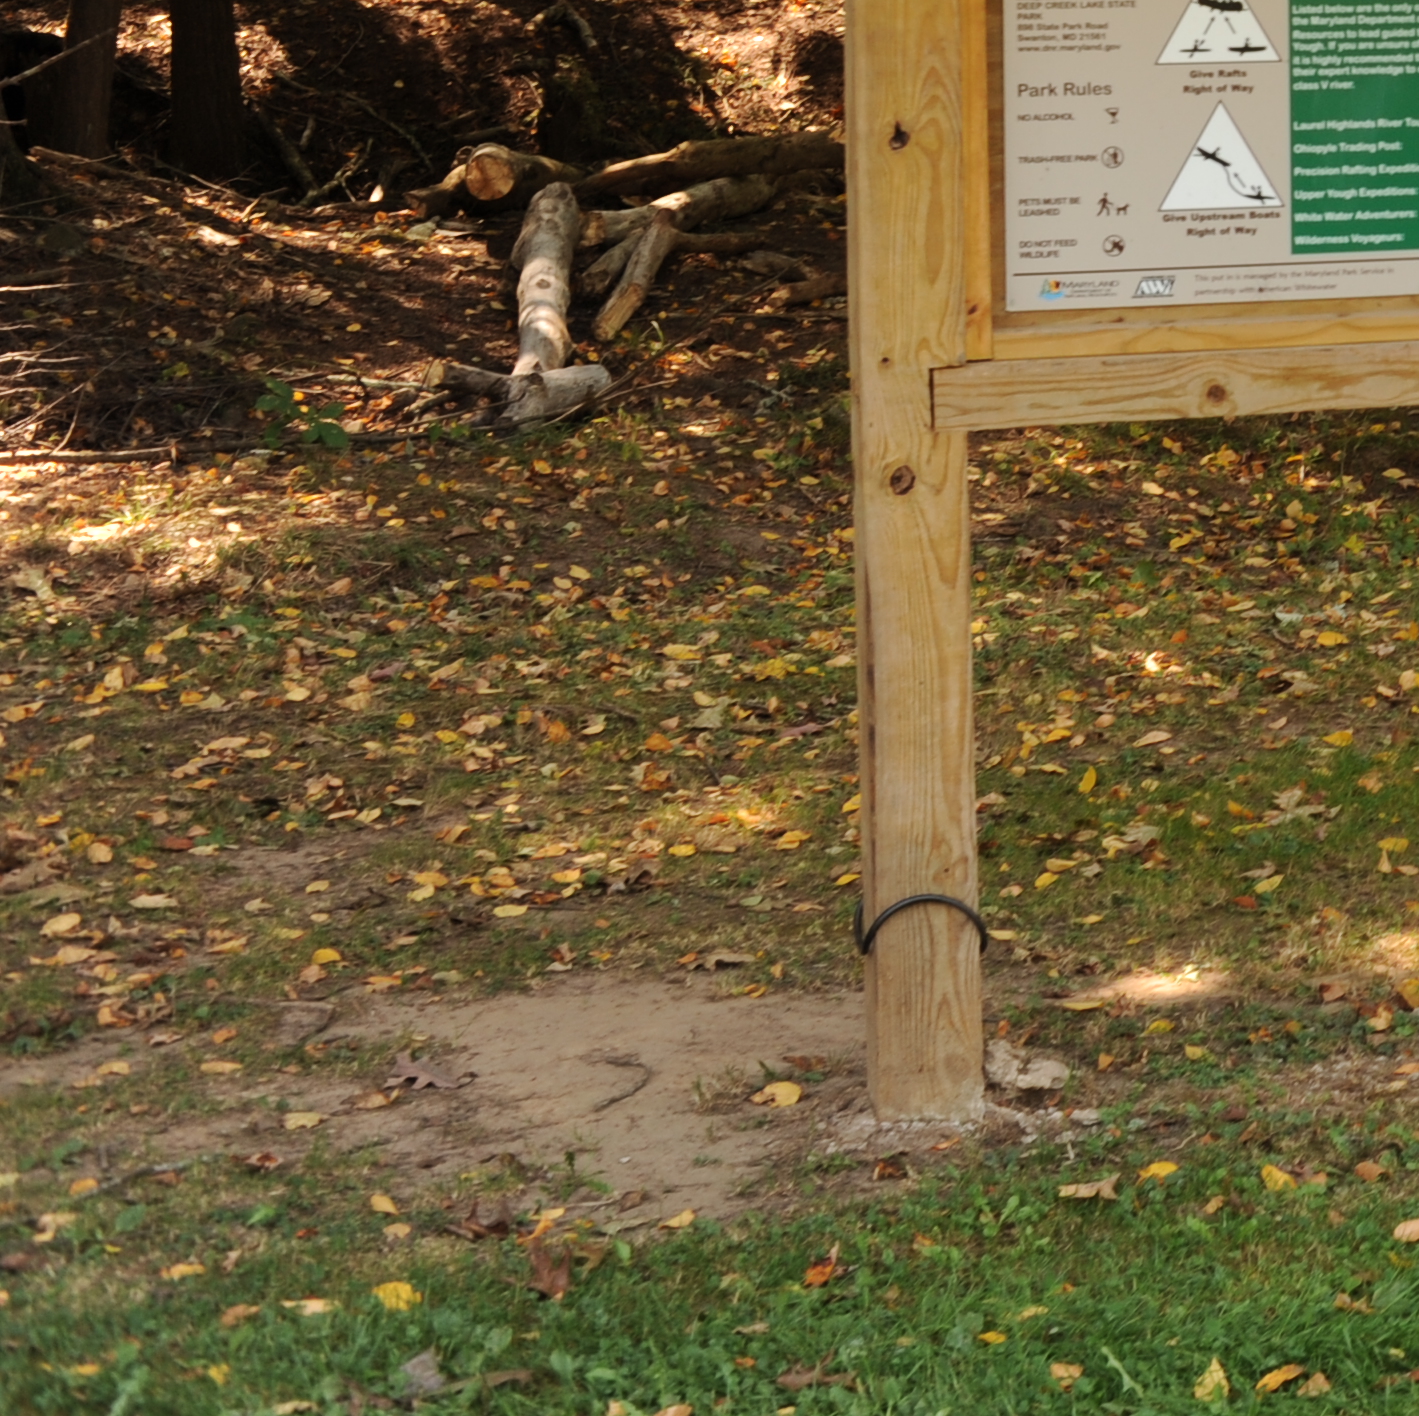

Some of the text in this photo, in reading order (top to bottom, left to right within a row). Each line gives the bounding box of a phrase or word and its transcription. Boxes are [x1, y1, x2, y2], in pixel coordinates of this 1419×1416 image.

[1017, 0, 1136, 10] DEEP CREEK LAKE STATE
[1189, 69, 1248, 79] Give Rafts
[1016, 82, 1113, 97] Park Rules
[1182, 84, 1254, 95] Right of Way
[1017, 113, 1075, 122] NO ALCOHOL
[1075, 154, 1098, 162] PARK
[1162, 211, 1281, 223] Give Upstream Boats
[1186, 226, 1258, 237] Right of Way
